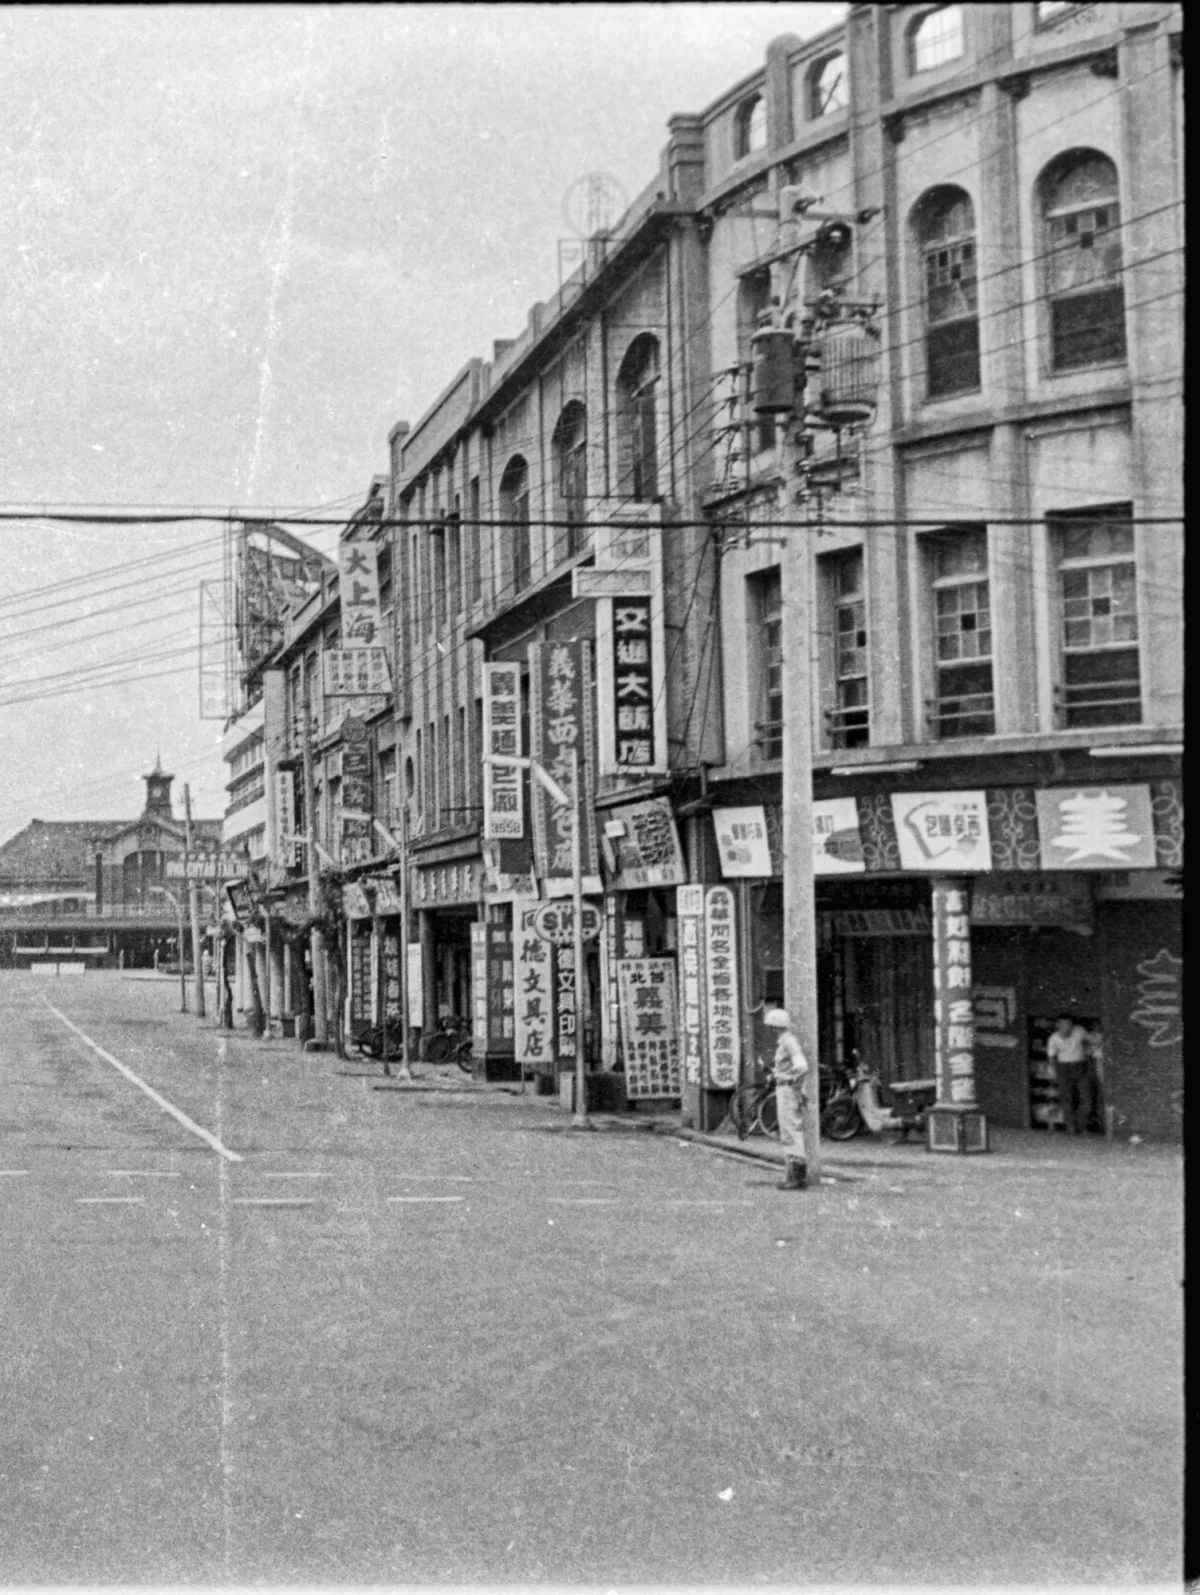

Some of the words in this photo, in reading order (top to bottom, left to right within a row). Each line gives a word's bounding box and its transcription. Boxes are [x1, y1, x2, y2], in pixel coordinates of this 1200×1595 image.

[345, 548, 377, 644] 大上海
[615, 608, 650, 764] 交通大飯店
[543, 910, 597, 930] SKB
